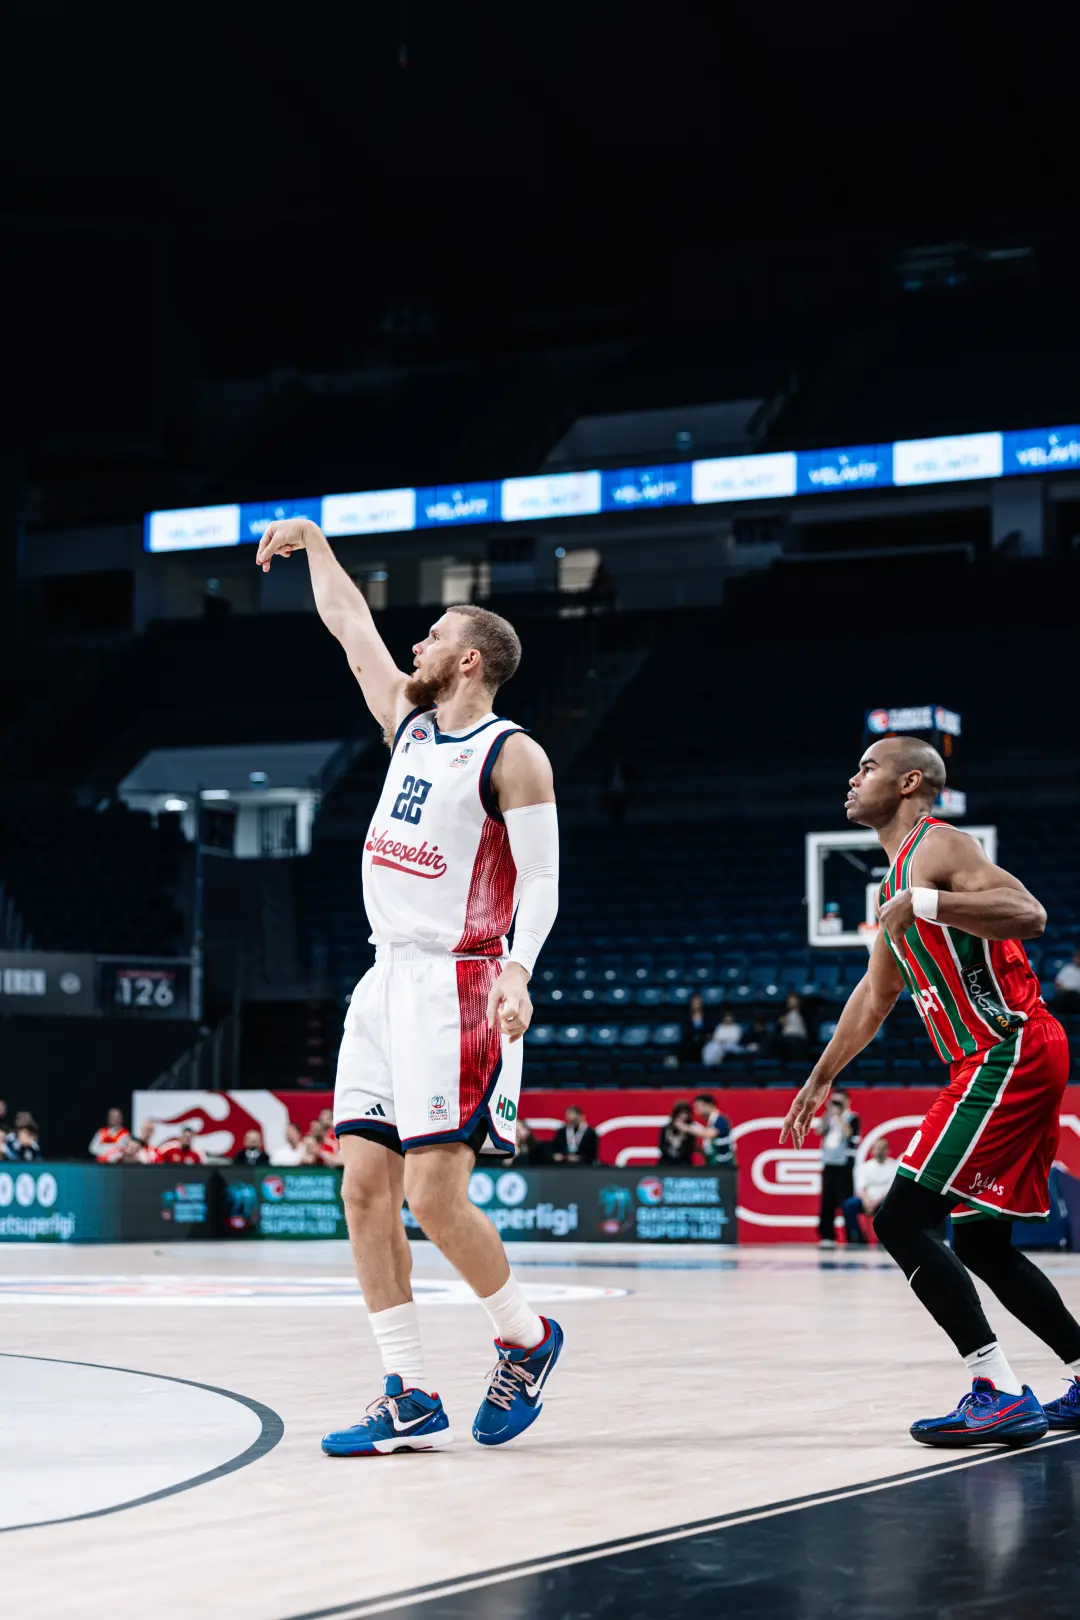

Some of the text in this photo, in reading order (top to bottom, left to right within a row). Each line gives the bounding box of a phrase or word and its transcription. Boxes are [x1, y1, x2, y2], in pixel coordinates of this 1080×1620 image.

[390, 774, 433, 826] 22
[118, 977, 174, 1006] 126
[911, 986, 946, 1017] RT
[495, 1094, 517, 1122] HD
